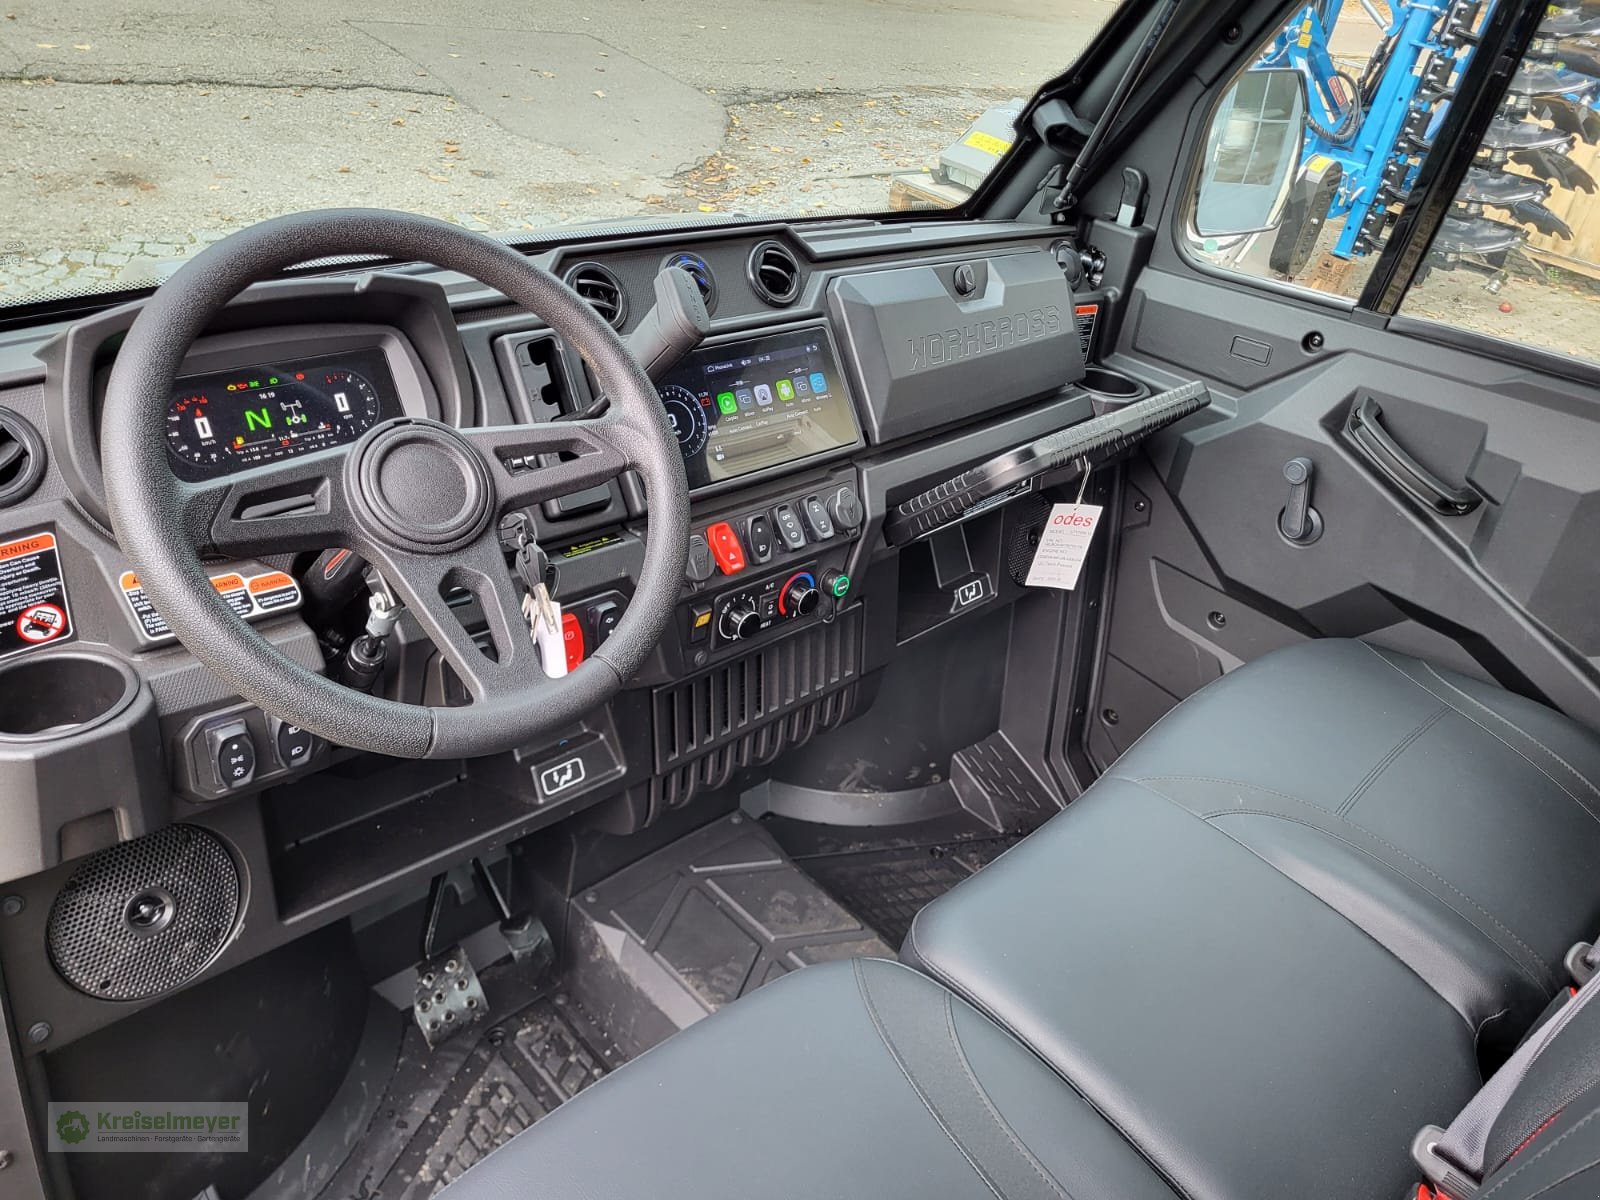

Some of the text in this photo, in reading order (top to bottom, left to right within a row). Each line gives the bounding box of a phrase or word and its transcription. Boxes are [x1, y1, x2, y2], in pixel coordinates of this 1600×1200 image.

[334, 392, 350, 412] 0
[194, 416, 213, 439] 0
[245, 408, 272, 431] N
[1053, 512, 1093, 527] odes
